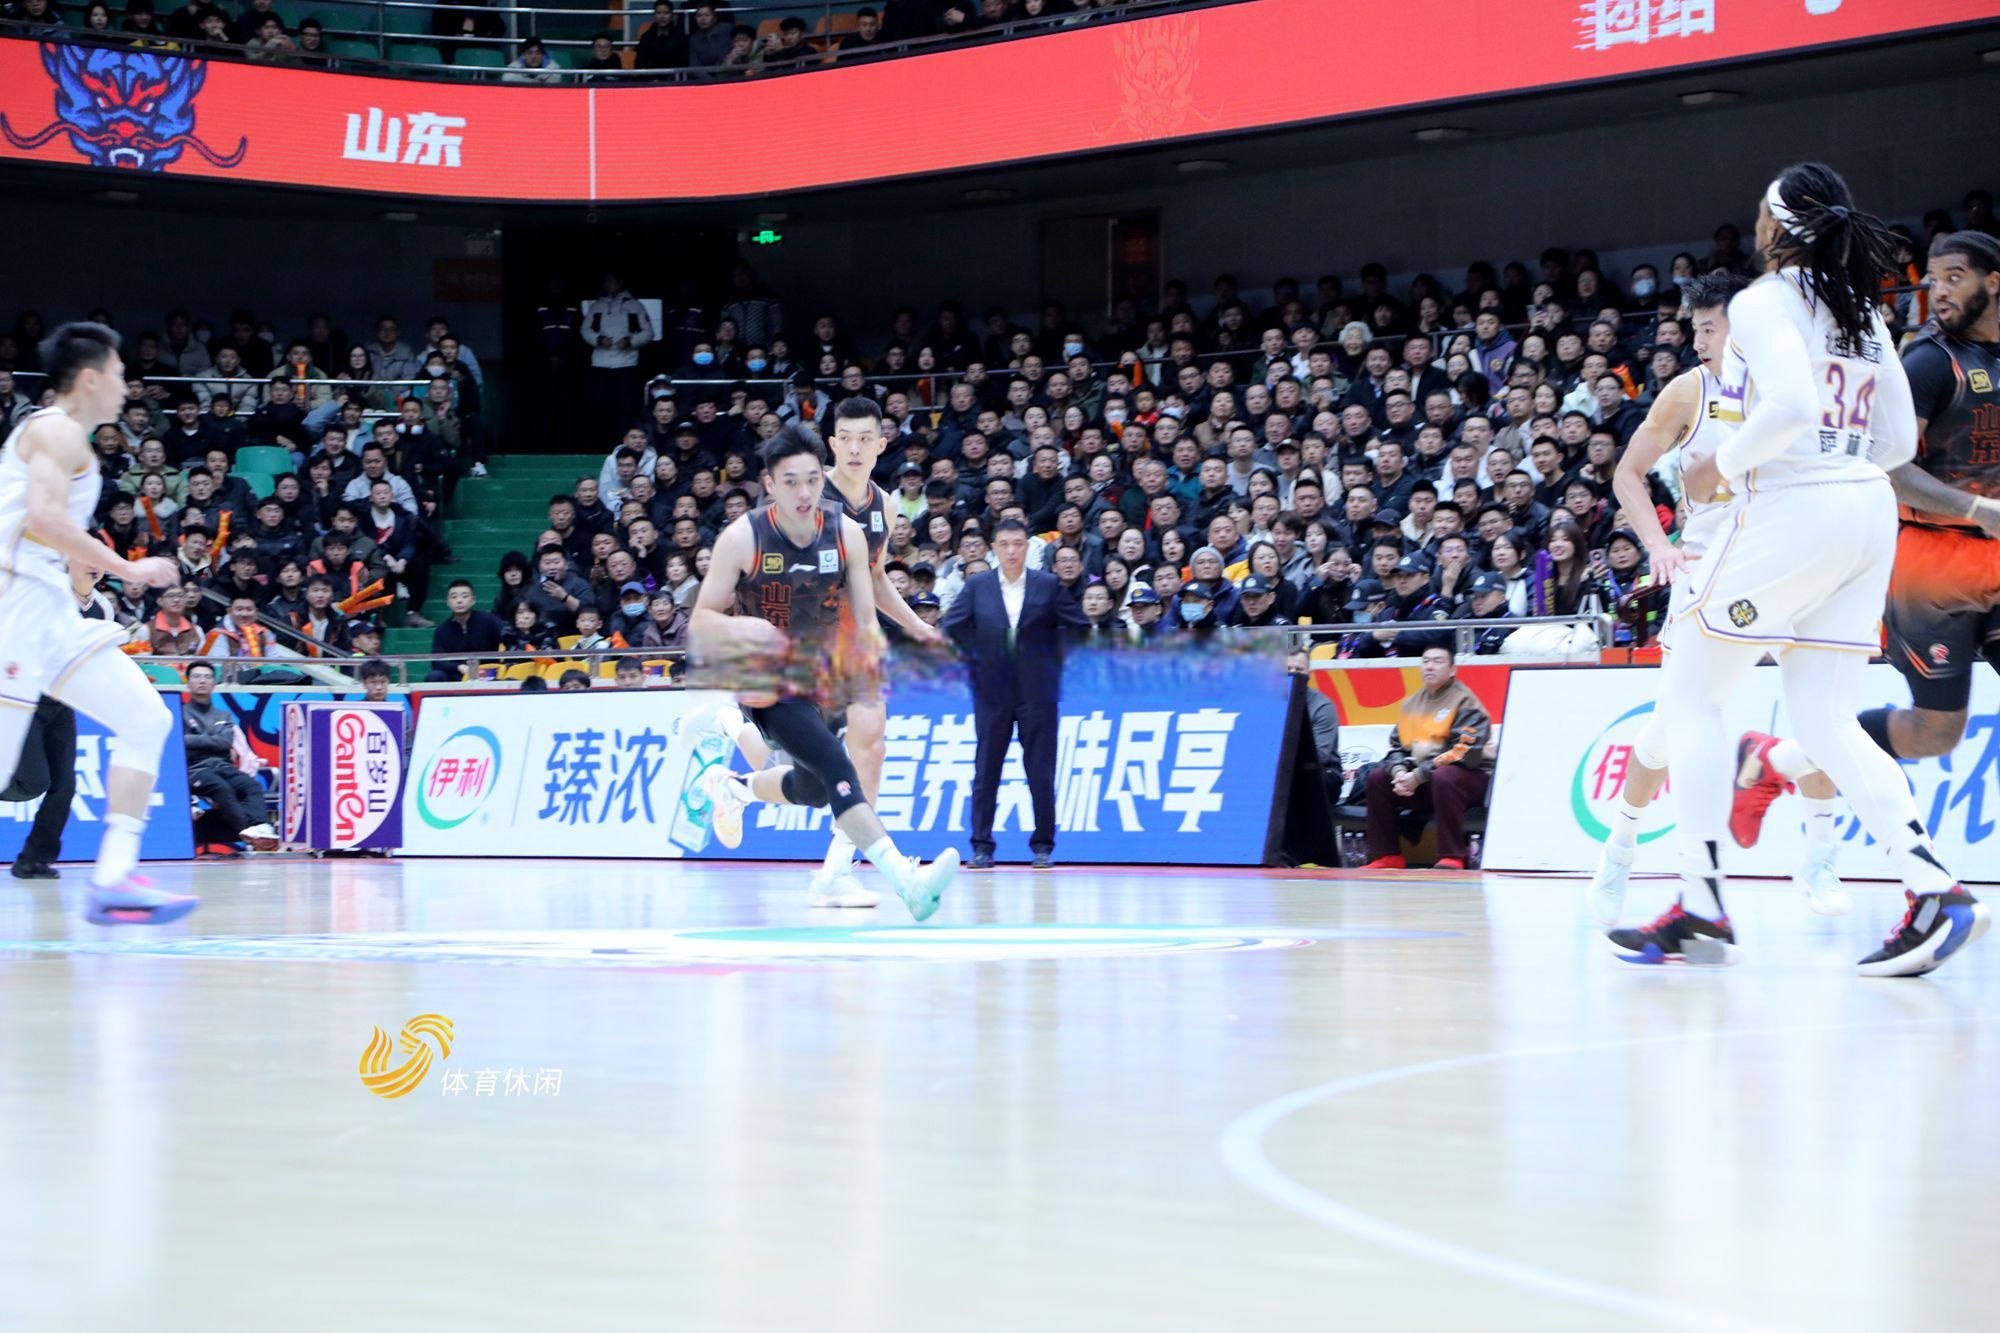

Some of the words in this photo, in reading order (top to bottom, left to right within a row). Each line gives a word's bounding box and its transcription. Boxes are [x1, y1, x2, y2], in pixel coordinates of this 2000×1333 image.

[342, 106, 467, 168] 山东
[1822, 362, 1877, 430] 34
[336, 713, 366, 842] Ganten
[367, 731, 389, 813] 百岁山
[429, 756, 490, 798] 伊利
[538, 727, 668, 826] 臻浓
